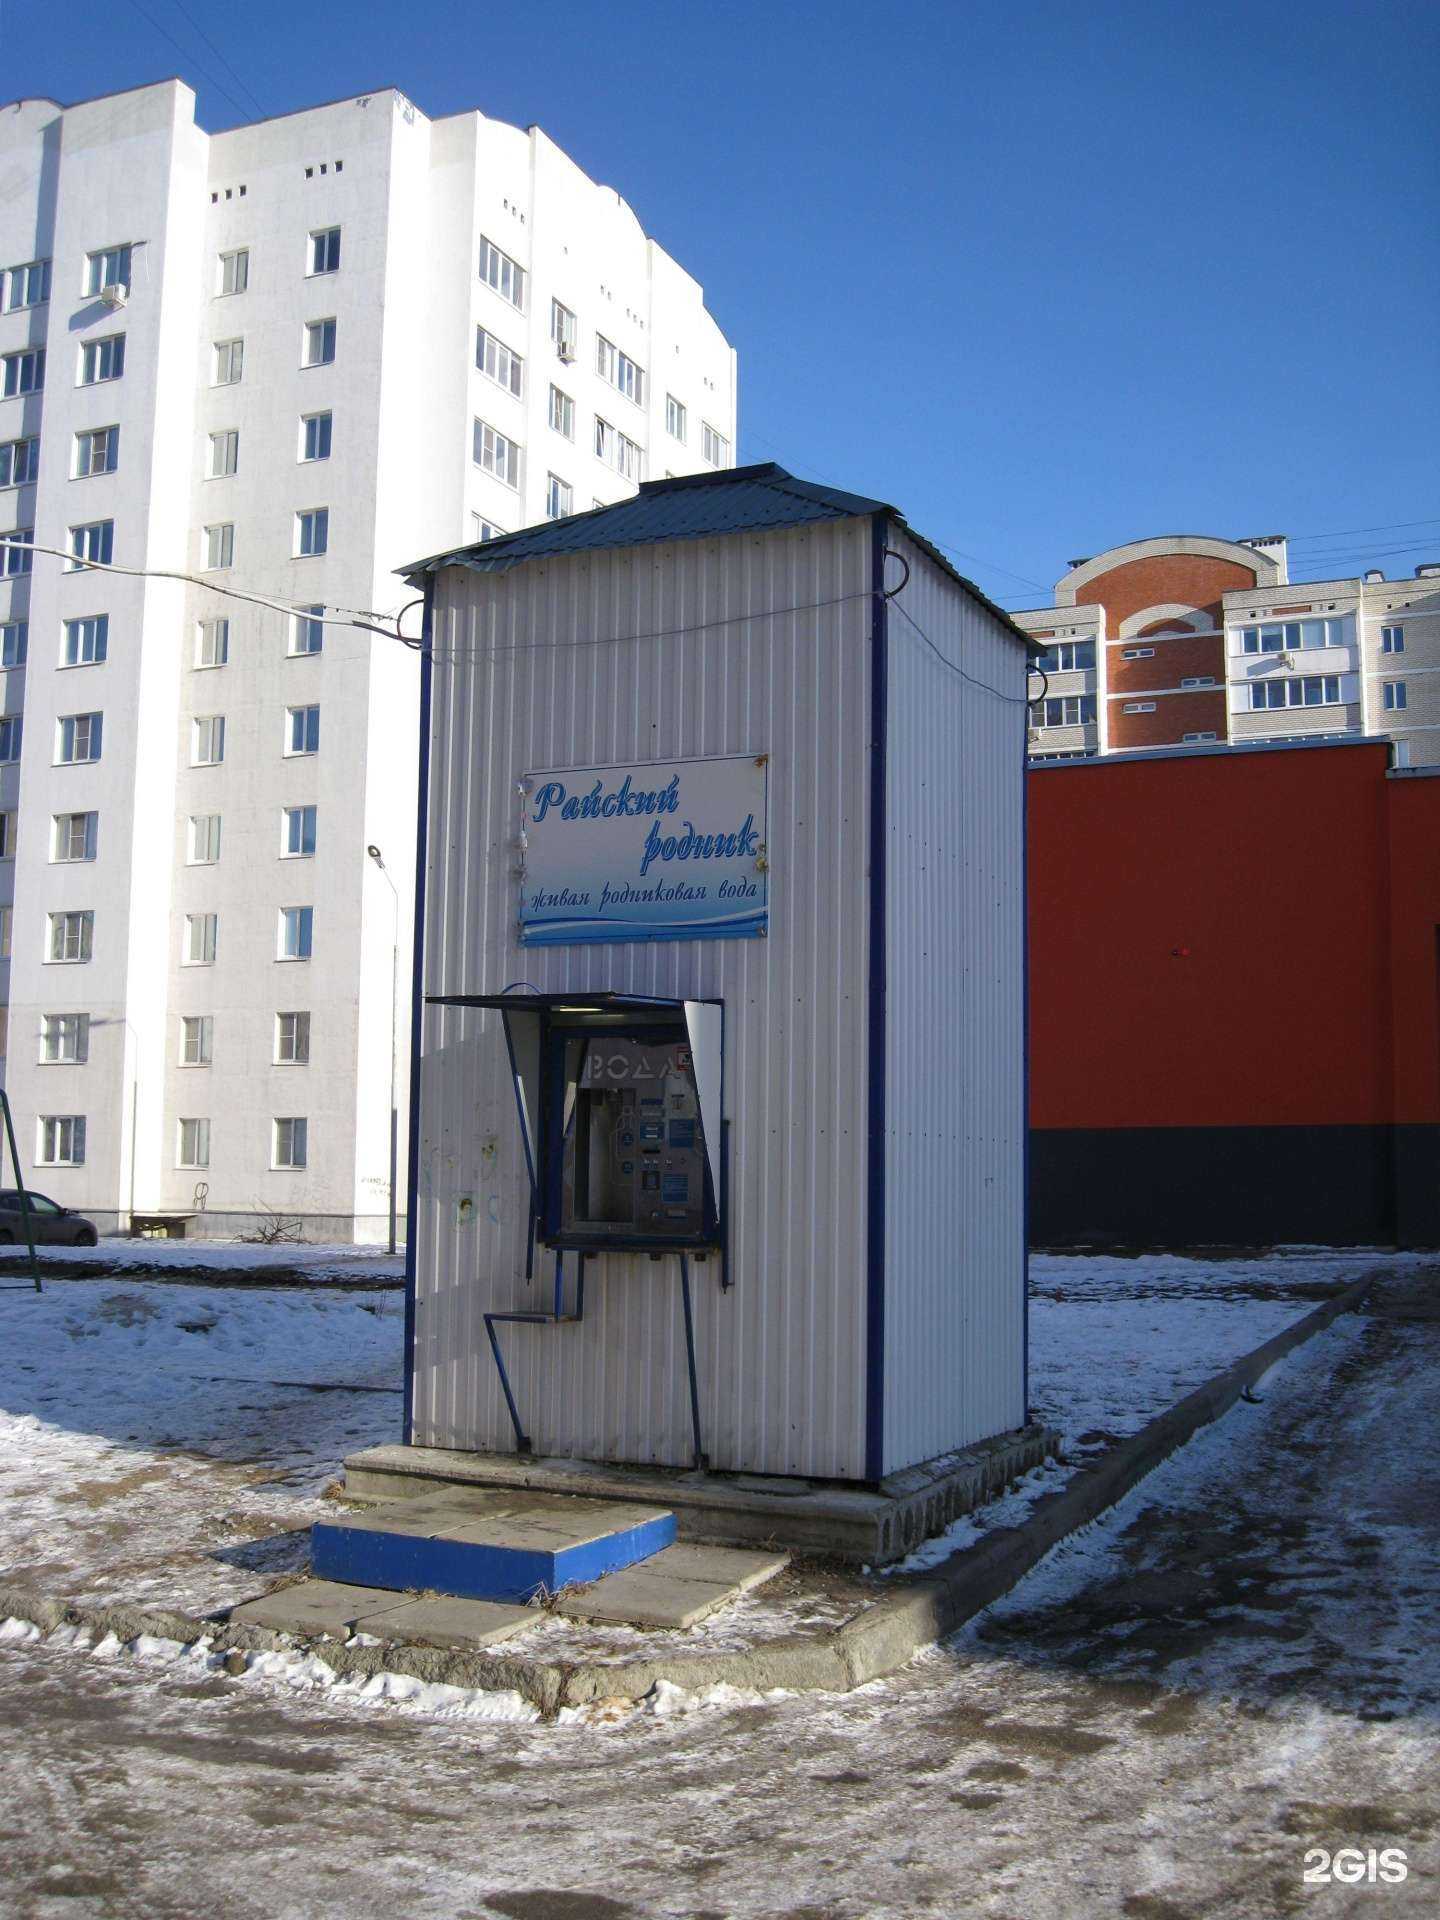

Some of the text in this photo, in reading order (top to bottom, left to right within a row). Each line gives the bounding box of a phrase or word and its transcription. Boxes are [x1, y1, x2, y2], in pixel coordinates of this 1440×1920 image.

[532, 774, 680, 823] Райский
[639, 814, 760, 877] родник
[531, 876, 757, 912] живая родниковая вода
[586, 1054, 681, 1080] ВОДА
